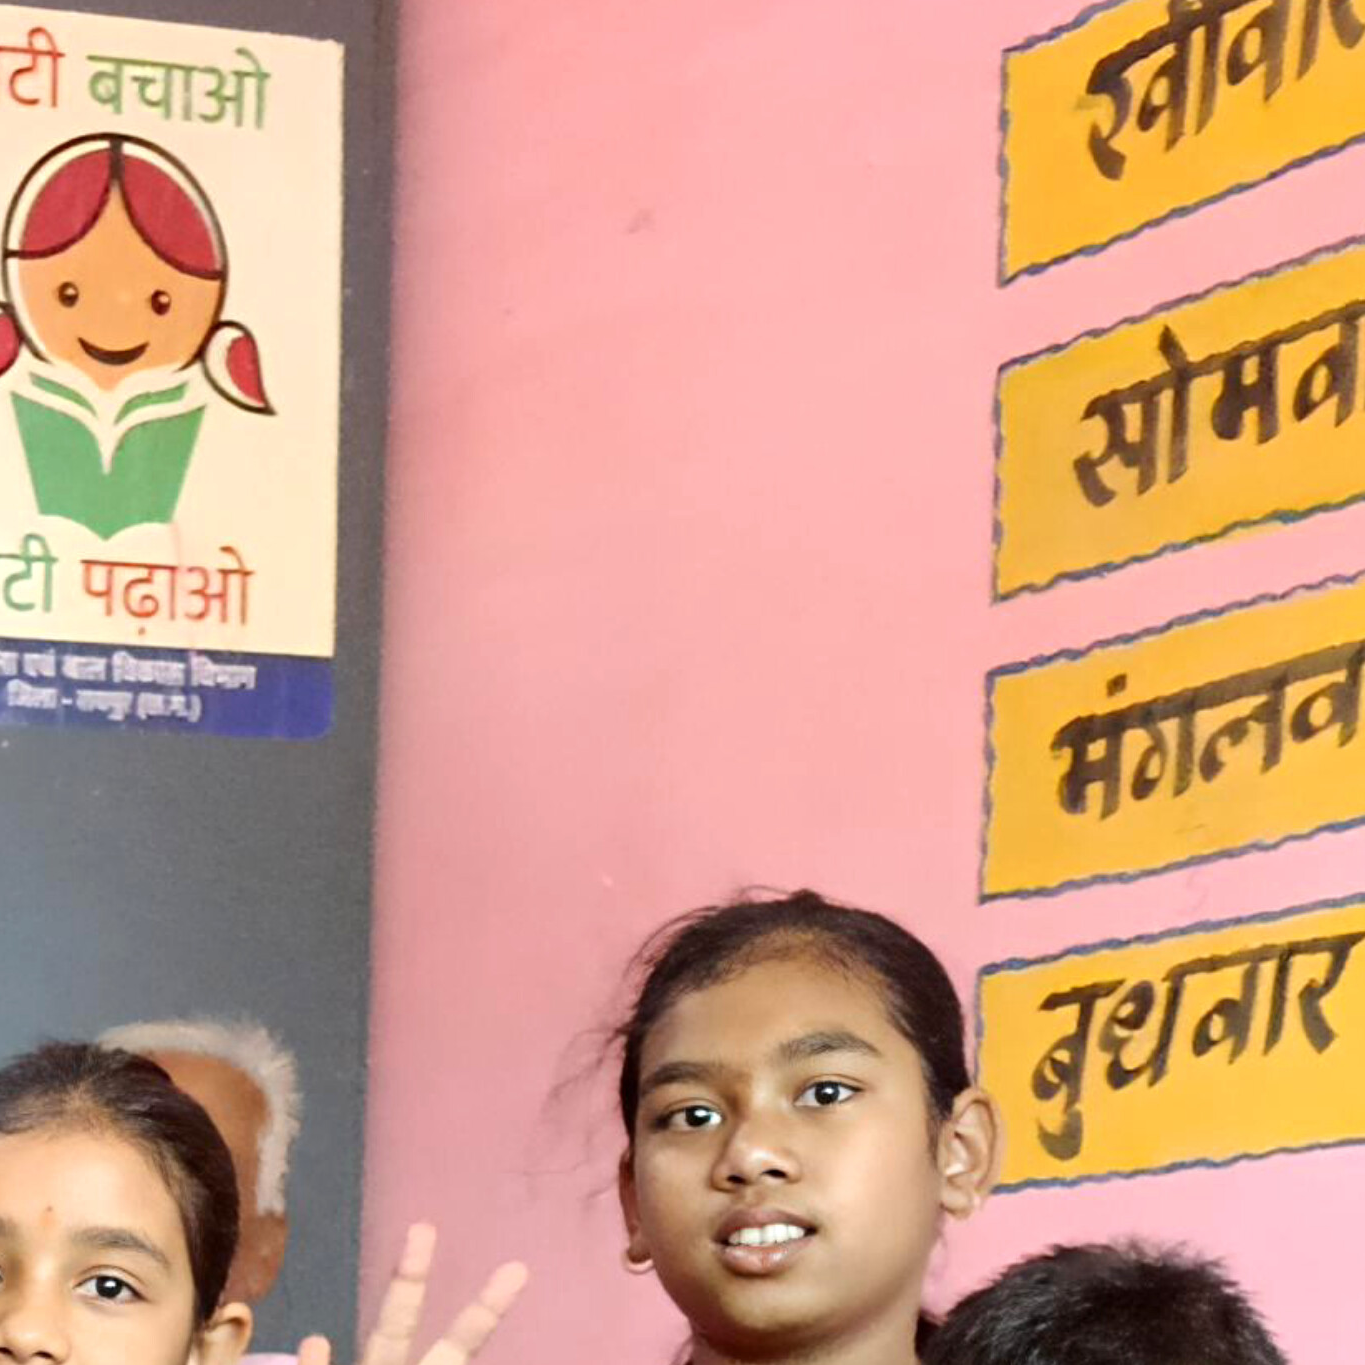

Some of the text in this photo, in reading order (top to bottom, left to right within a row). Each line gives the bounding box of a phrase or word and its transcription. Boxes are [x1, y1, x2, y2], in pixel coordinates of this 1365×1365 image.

[85, 47, 271, 130] बचाओ
[1072, 298, 1365, 508] सोमव
[79, 545, 256, 637] पढ़ाओ
